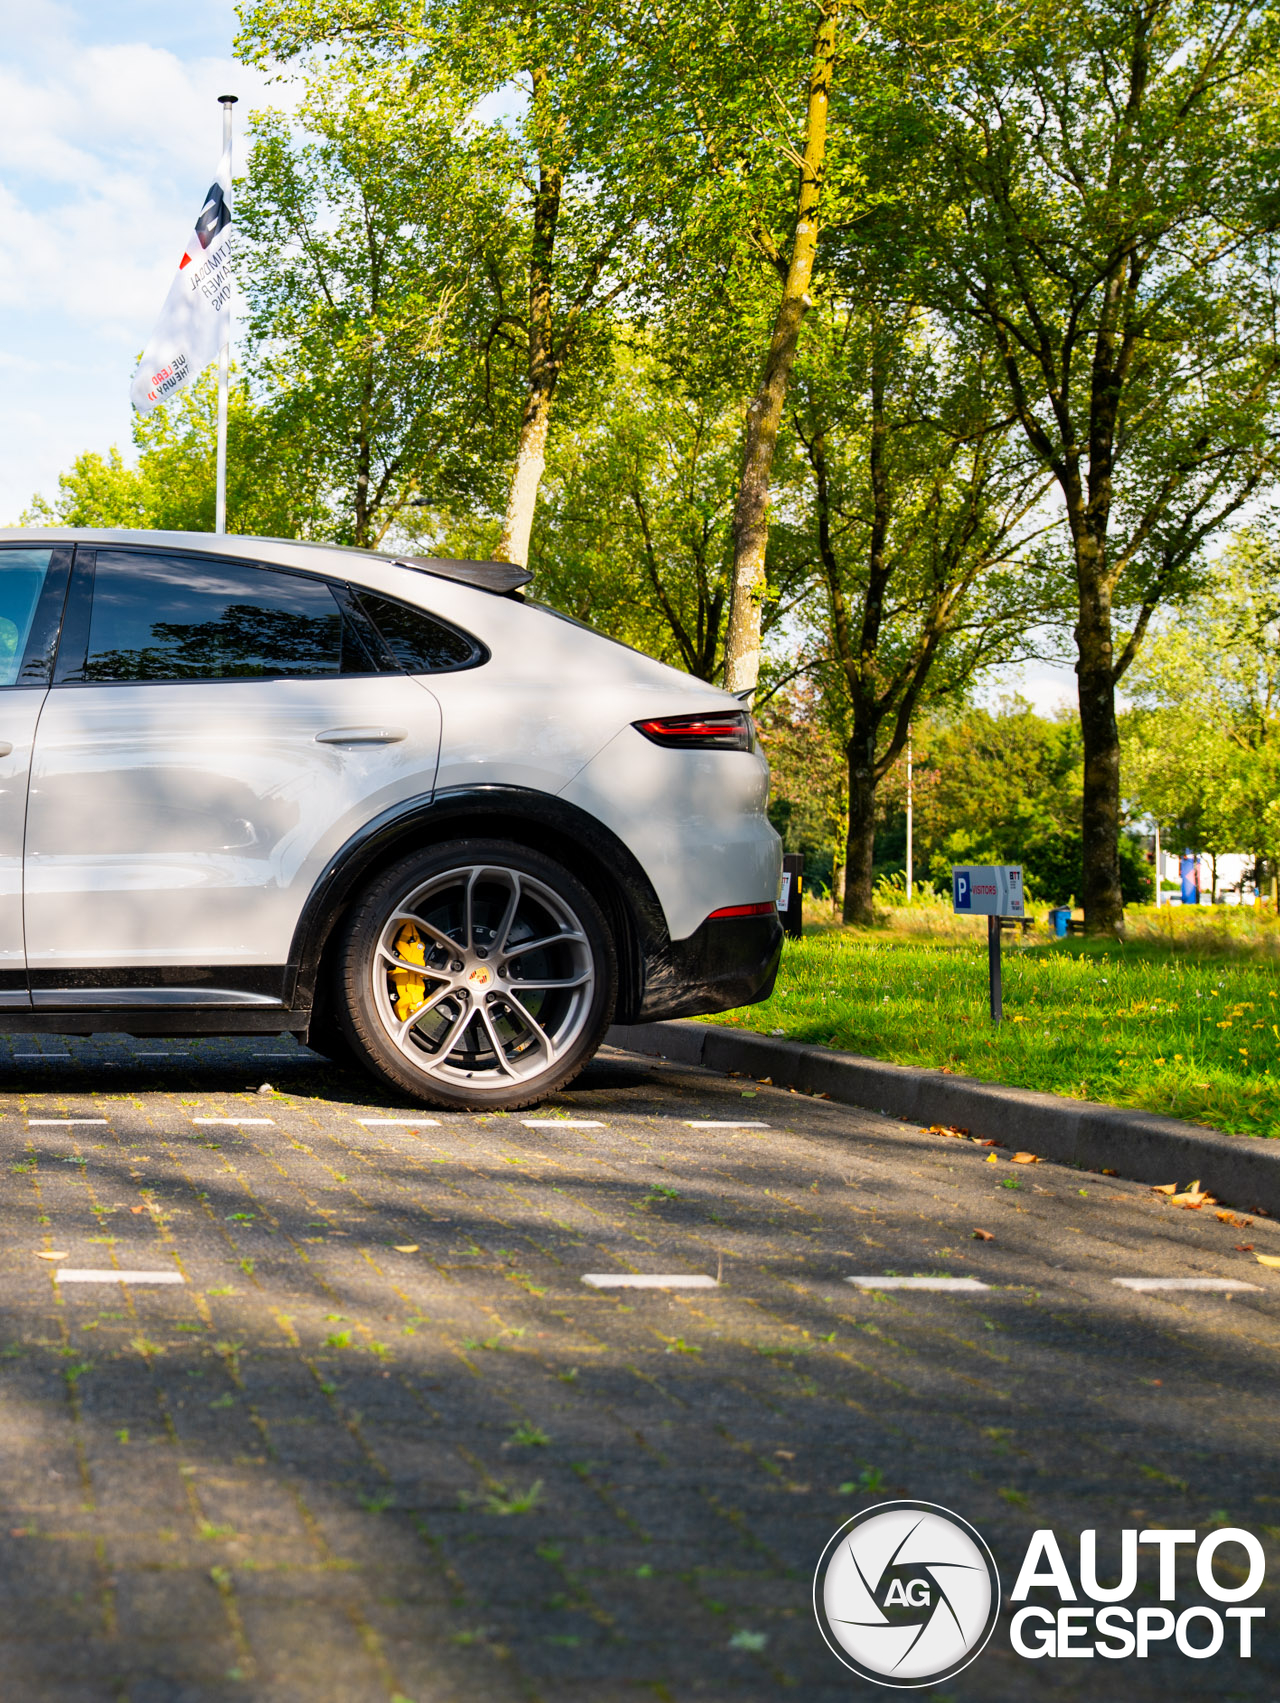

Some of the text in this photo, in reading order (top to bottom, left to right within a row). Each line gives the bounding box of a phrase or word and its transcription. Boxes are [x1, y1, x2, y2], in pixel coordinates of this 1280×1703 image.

[1009, 871, 1020, 880] BTT
[958, 878, 966, 902] P
[971, 885, 997, 895] VISITORS
